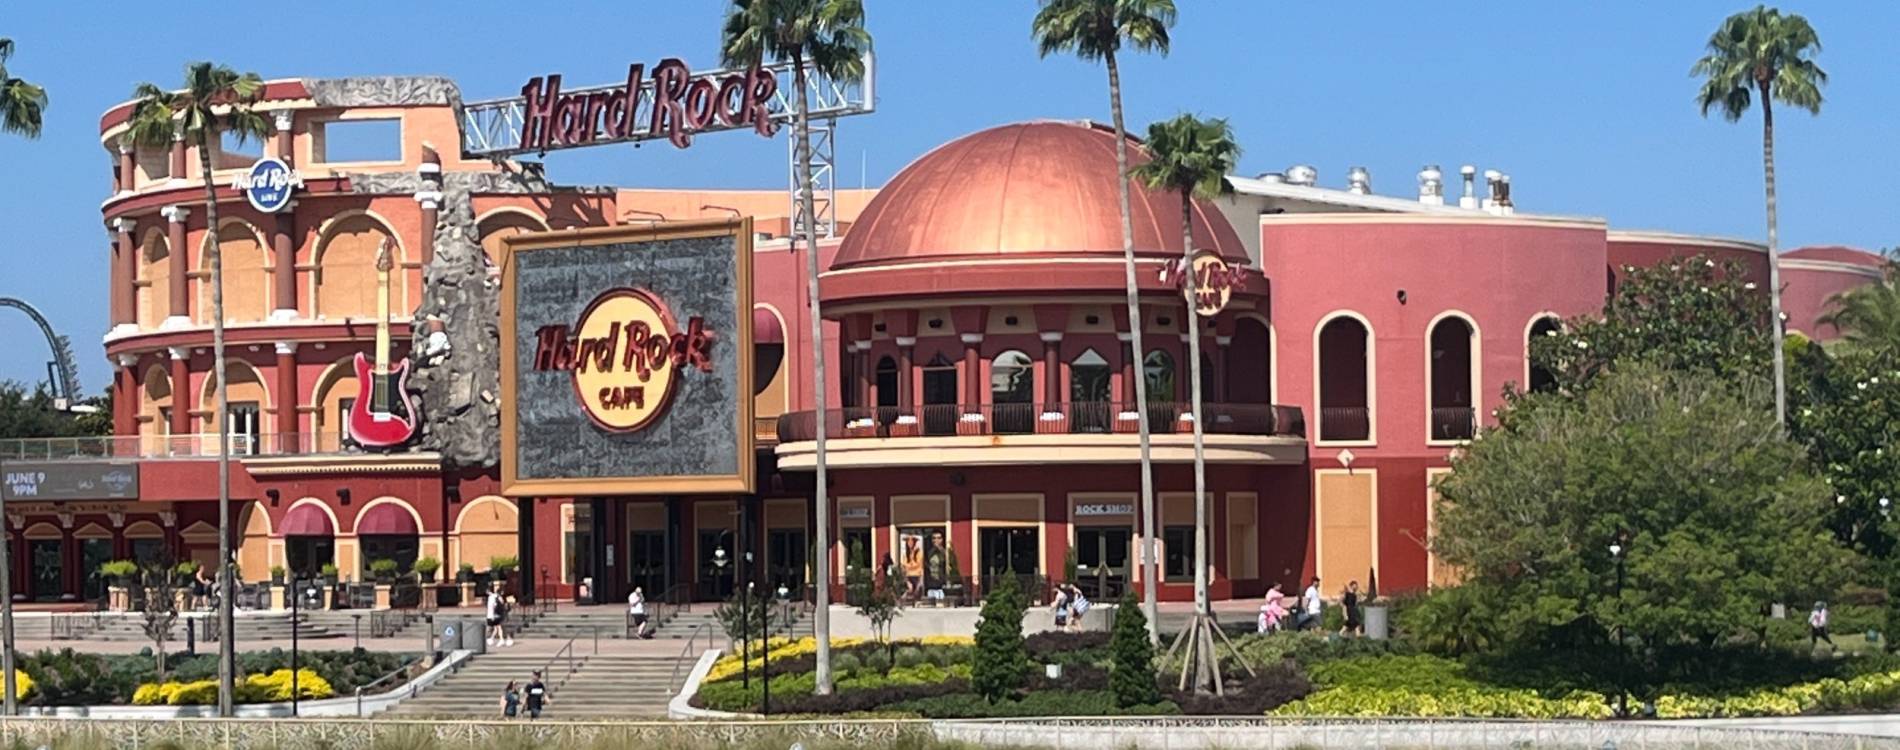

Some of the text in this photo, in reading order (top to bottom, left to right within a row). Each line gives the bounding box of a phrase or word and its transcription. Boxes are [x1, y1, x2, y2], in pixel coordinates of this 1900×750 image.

[520, 57, 778, 149] Hard Rock
[231, 167, 304, 191] Hard Rock
[533, 316, 715, 382] Hard Rock
[598, 386, 645, 410] CAFE
[5, 472, 46, 485] JUNE 9
[12, 484, 38, 496] 9PM
[1075, 504, 1105, 515] ROCK
